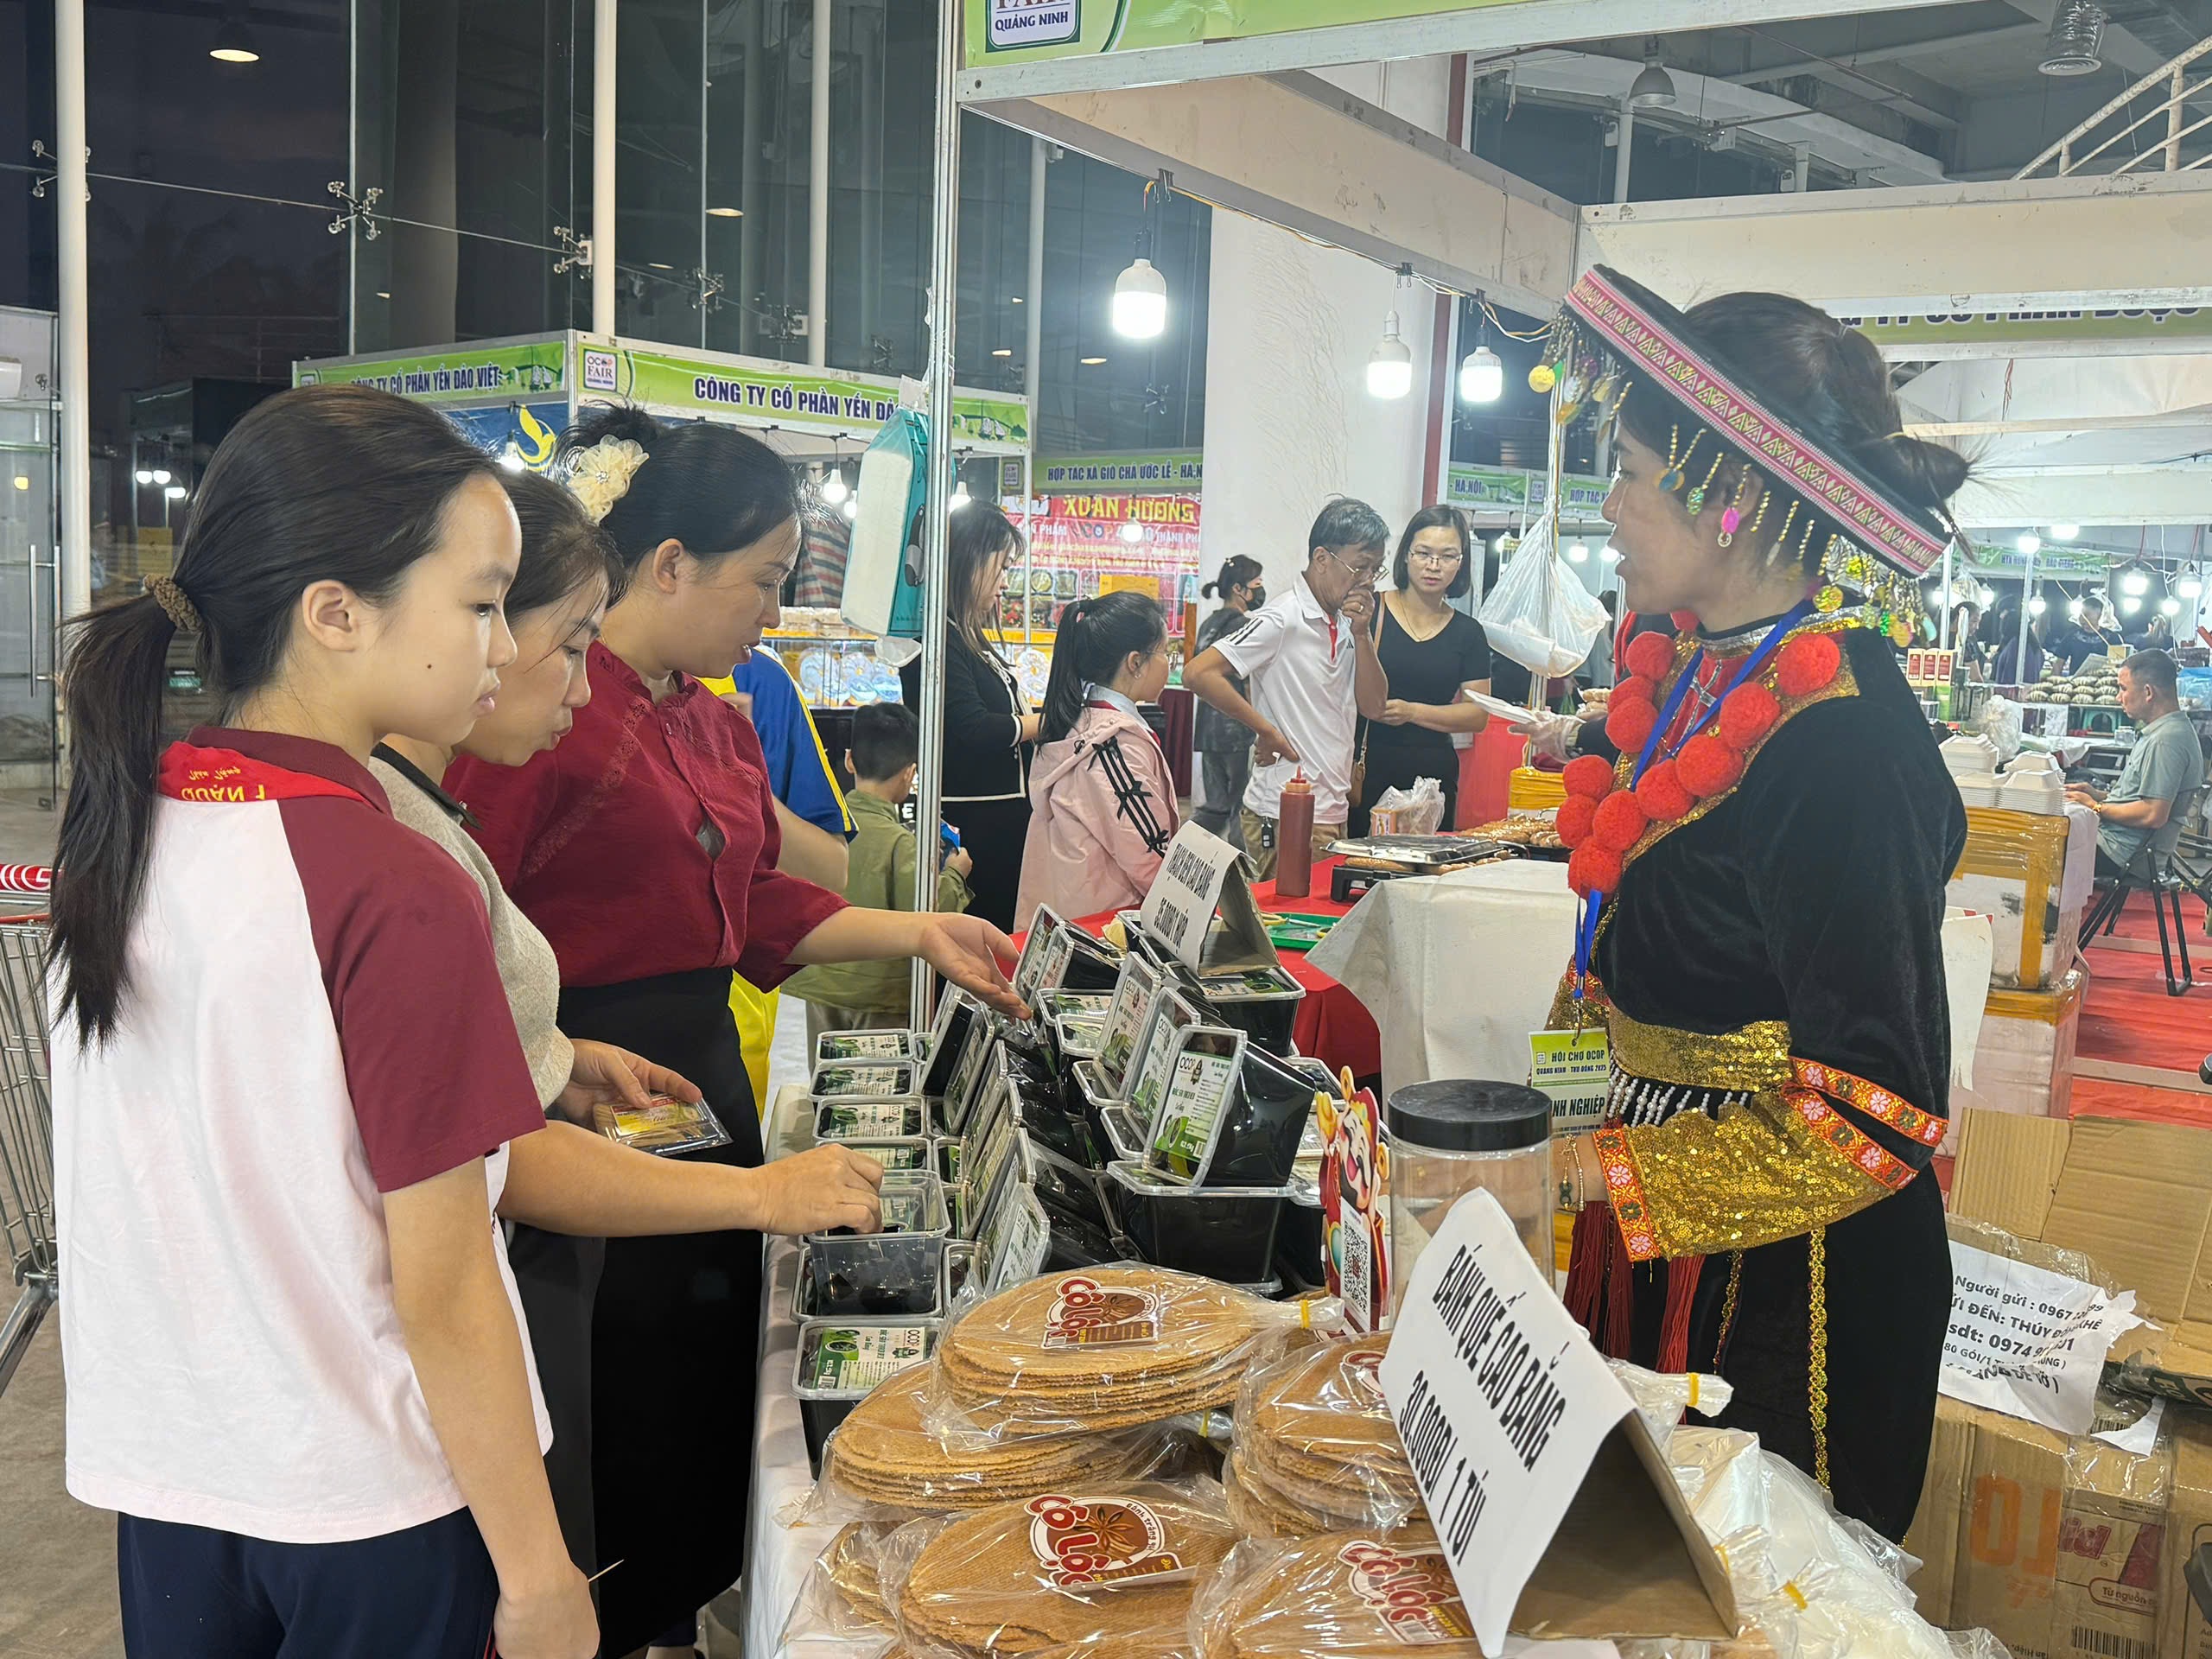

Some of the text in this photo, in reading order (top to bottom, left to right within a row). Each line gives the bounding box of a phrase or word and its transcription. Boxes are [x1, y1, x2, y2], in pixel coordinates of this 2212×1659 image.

[995, 11, 1069, 31] QUẢNG NINH
[477, 361, 499, 391] VIỆT
[588, 365, 613, 378] FAIR
[695, 376, 899, 422] CÔNG TY CỔ PHẦN YẾN ĐẢ
[1552, 1049, 1605, 1063] HỘI CHỢ OCOP
[1569, 1094, 1605, 1118] NGHIỆP
[1433, 1244, 1485, 1338] BÁNH
[1955, 1275, 2000, 1299] Người
[2001, 1292, 2028, 1307] gửi
[1454, 1287, 1527, 1372] QUẾ
[1967, 1303, 2005, 1325] ĐẾN:
[2010, 1316, 2052, 1338] THÚY
[1948, 1323, 1984, 1344] sdt:
[1988, 1334, 2033, 1357] 0974
[1478, 1320, 1529, 1410] CAO
[1446, 1469, 1489, 1567] TÚI
